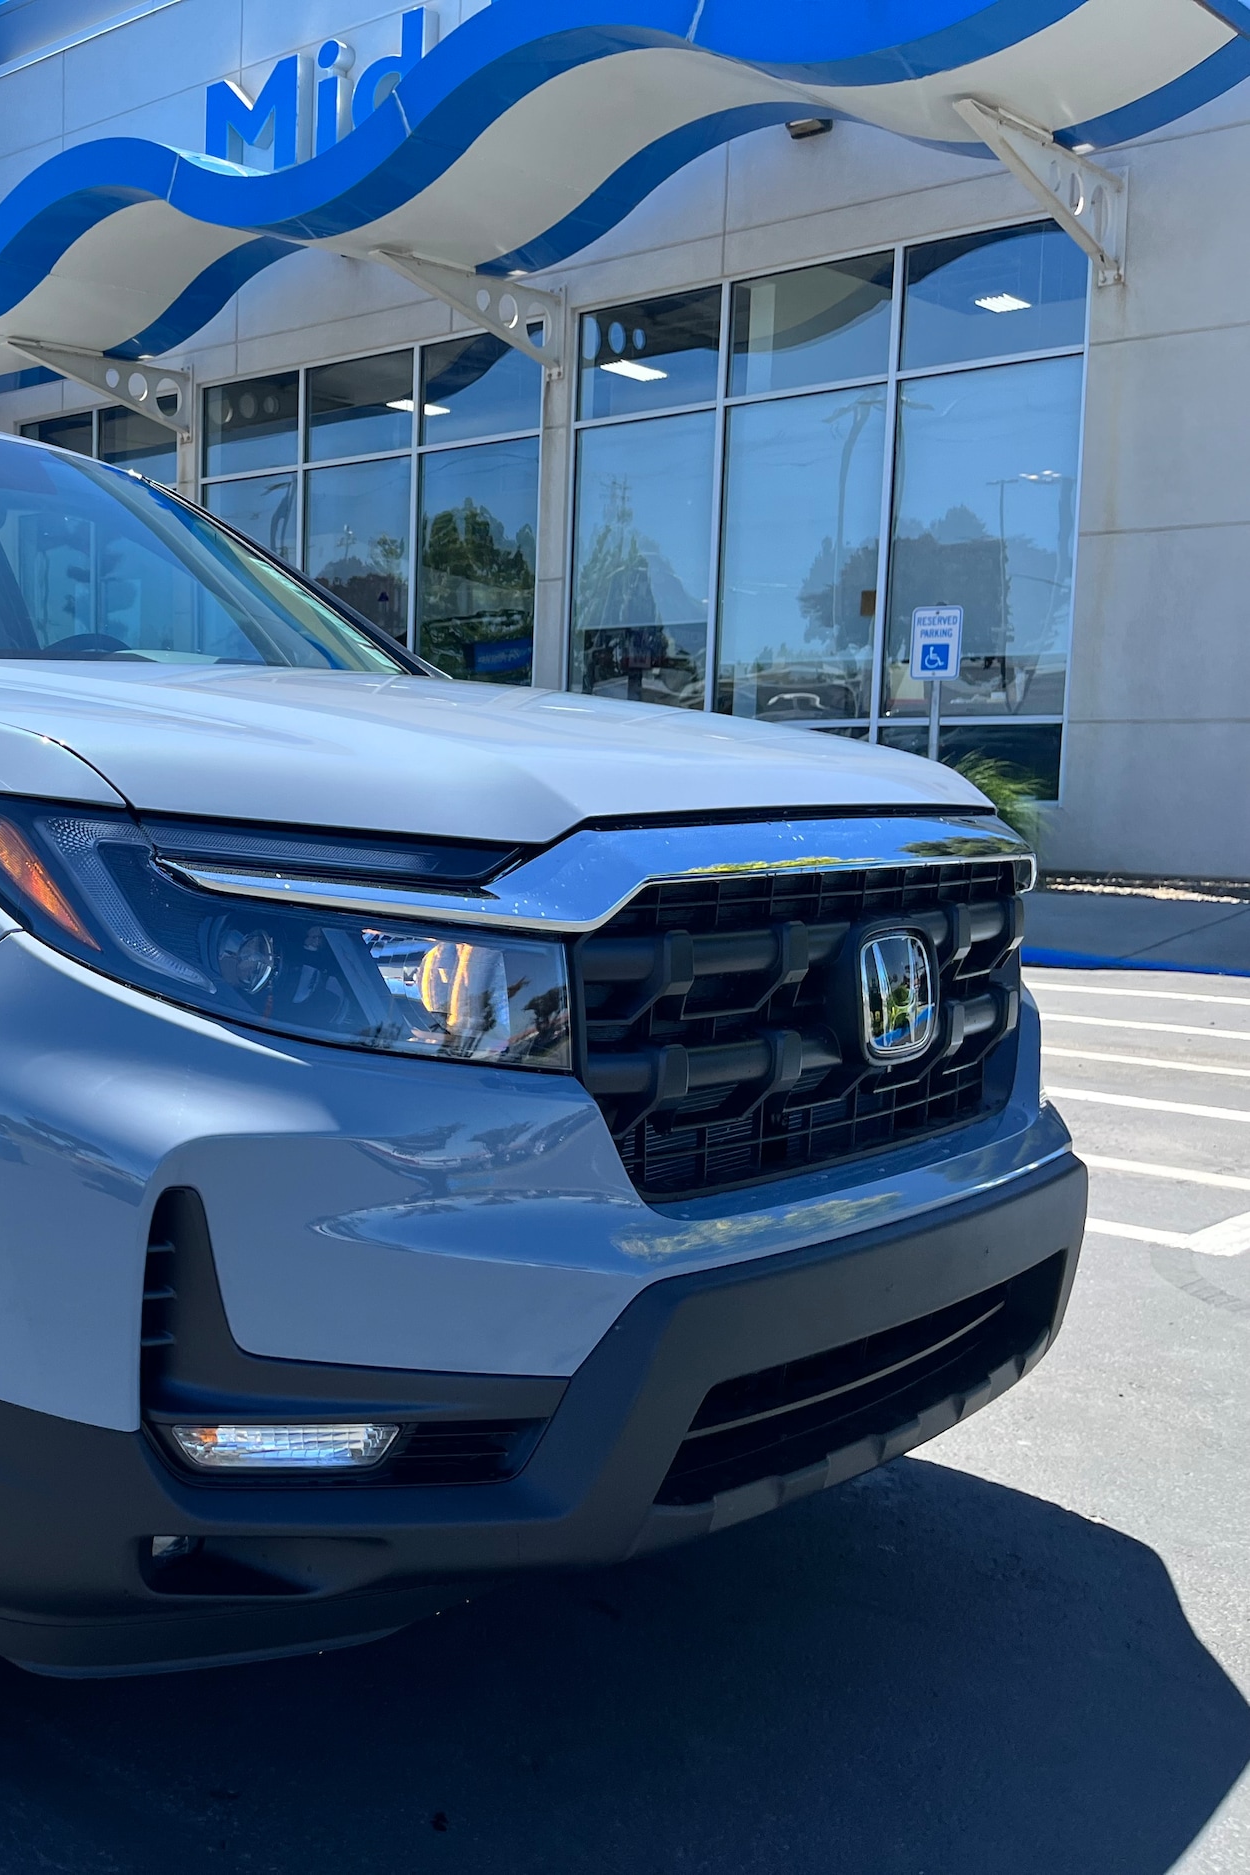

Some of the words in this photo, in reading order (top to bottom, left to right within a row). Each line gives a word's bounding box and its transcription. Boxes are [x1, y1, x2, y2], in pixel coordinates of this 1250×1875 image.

[205, 6, 439, 172] Mid
[916, 615, 958, 627] RESERVED
[919, 628, 953, 639] PARKING
